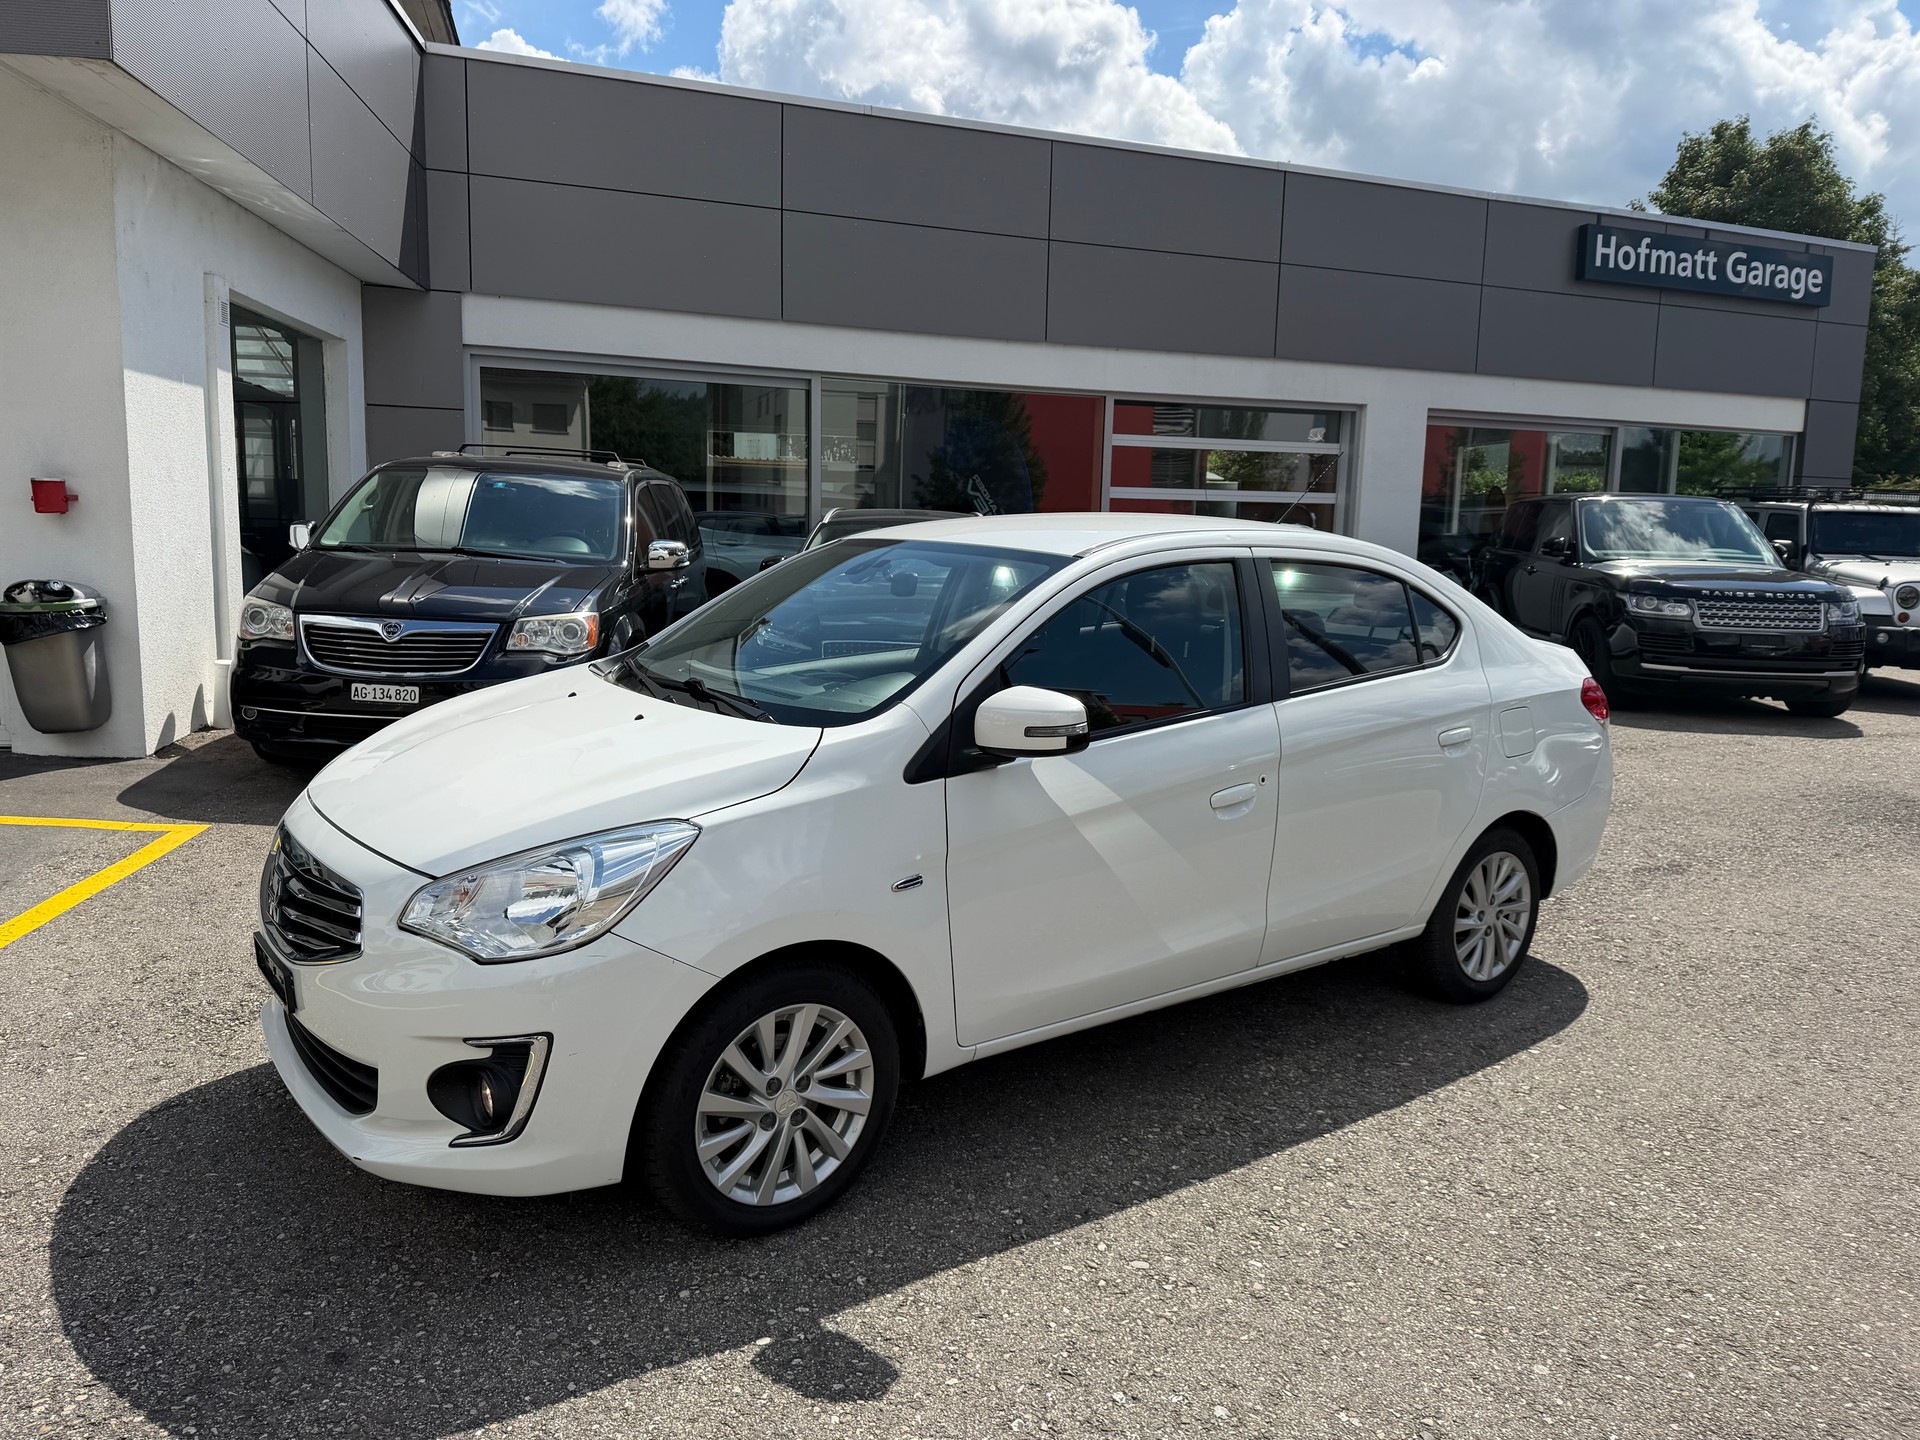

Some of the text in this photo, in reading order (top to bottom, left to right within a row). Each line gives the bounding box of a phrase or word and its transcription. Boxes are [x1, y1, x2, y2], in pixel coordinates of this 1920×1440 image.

[1594, 233, 1824, 300] Hofmatt Garage
[1701, 589, 1756, 598] RANGE
